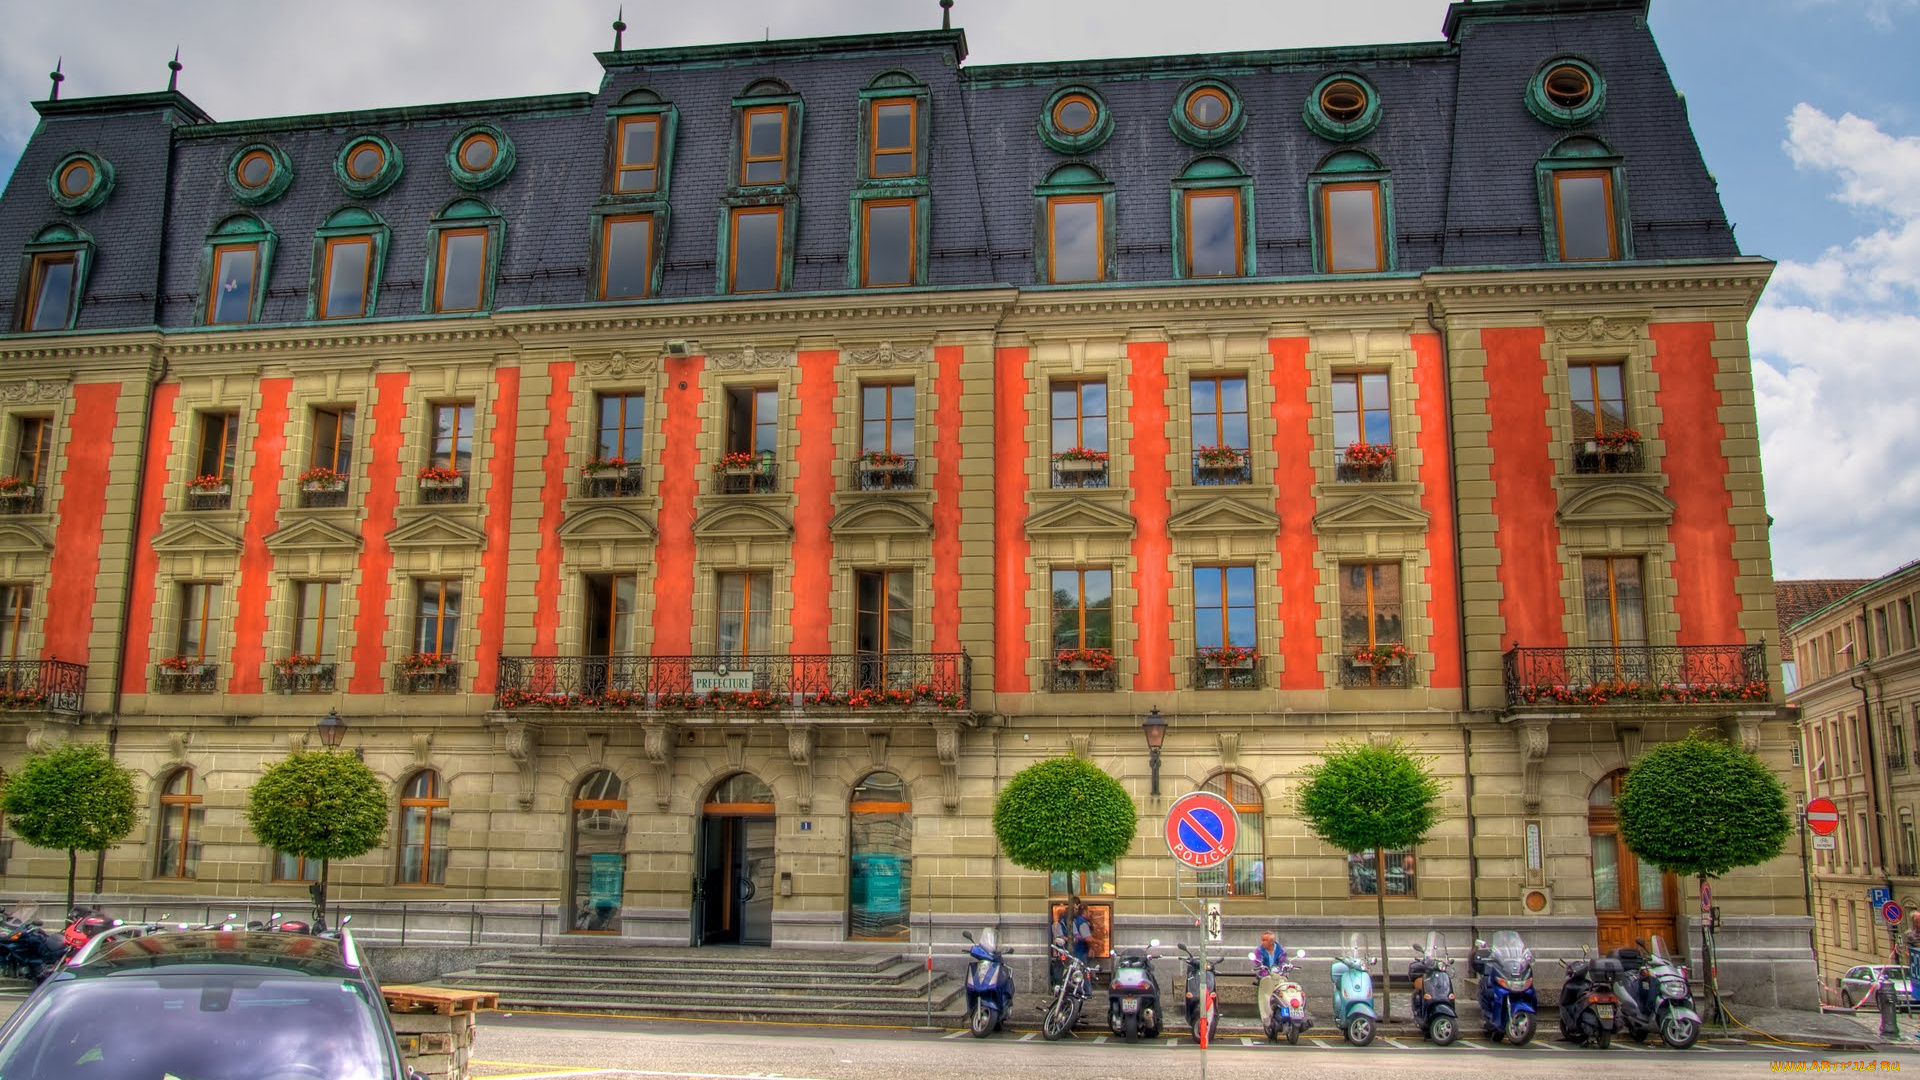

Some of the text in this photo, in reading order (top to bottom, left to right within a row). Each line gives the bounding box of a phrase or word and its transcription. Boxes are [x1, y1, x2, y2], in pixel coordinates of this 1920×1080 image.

[696, 678, 750, 689] PREFECTURE
[1174, 843, 1228, 865] POLICE
[1874, 889, 1883, 901] P
